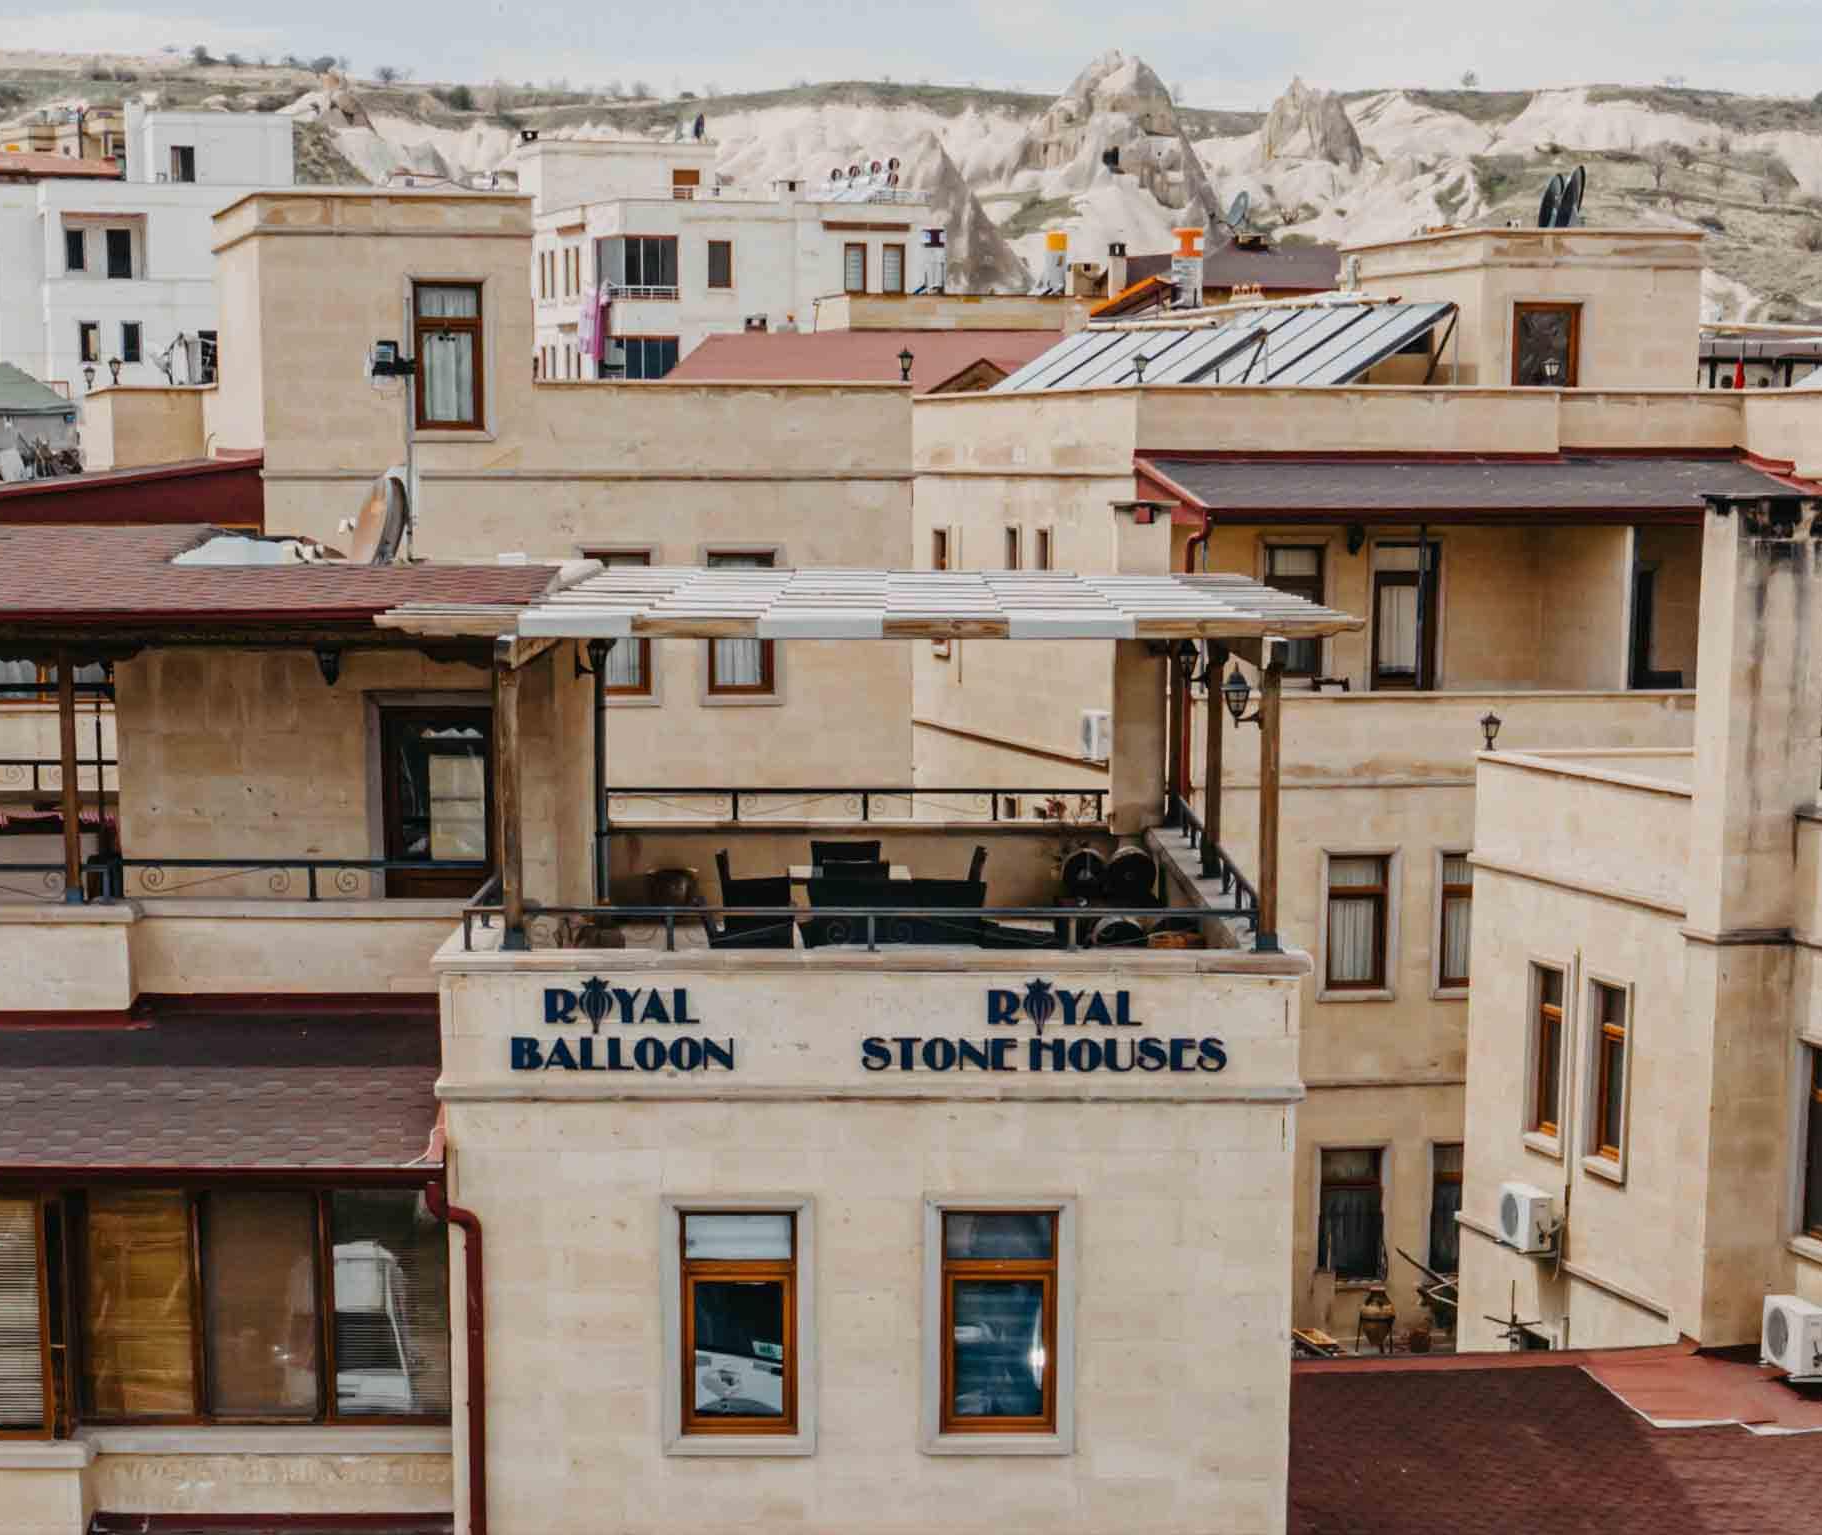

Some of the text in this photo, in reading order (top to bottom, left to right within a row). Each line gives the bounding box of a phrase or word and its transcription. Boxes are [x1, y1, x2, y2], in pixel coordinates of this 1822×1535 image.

[544, 977, 699, 1034] ROYAL
[987, 979, 1142, 1036] ROYAL
[511, 1037, 734, 1072] BALLOON
[862, 1037, 1227, 1073] STONE HOUSES
